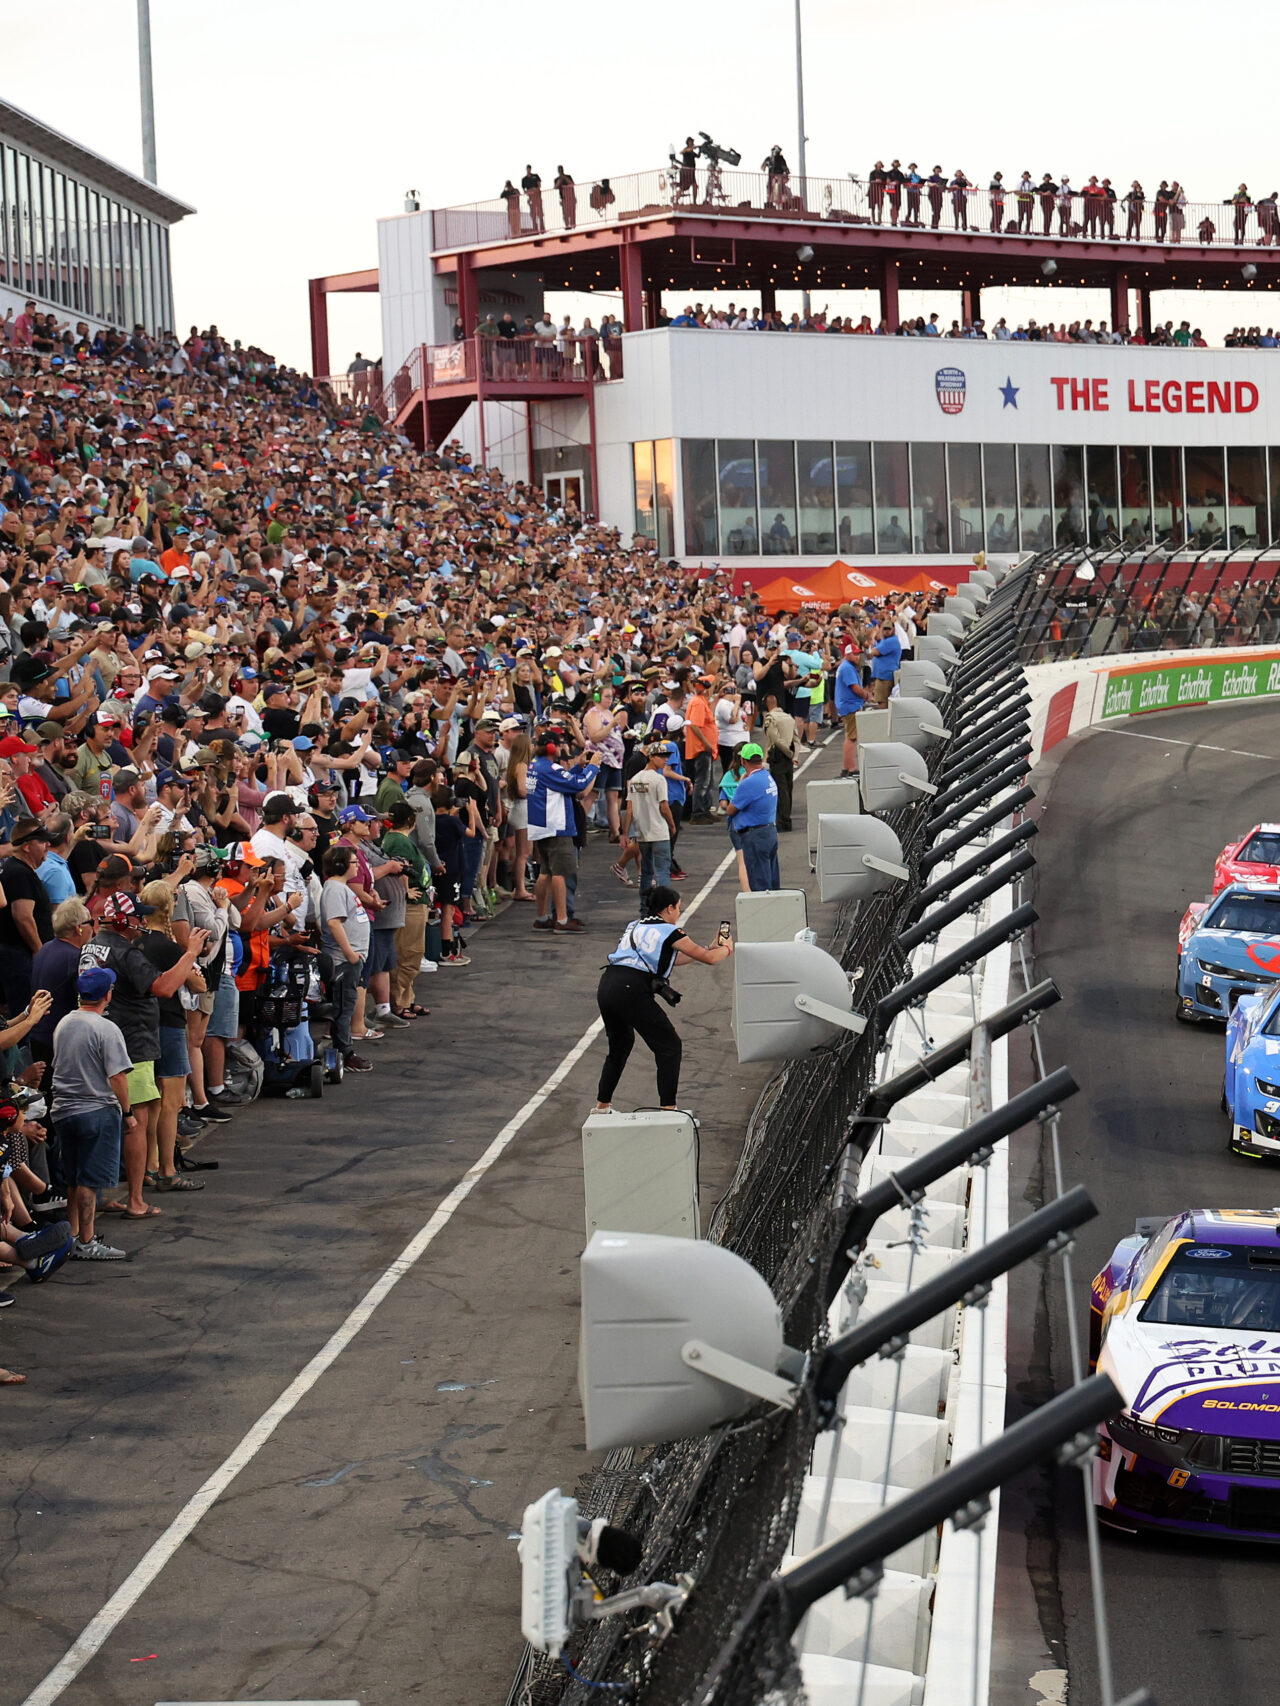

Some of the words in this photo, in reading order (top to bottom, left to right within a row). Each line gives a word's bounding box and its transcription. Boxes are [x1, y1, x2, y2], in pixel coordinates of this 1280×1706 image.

[1050, 377, 1109, 411] THE
[1128, 379, 1259, 413] LEGEND
[1177, 668, 1213, 701] EchoPark
[1221, 665, 1258, 696] EchoPark
[1202, 976, 1212, 988] 8
[1263, 1101, 1280, 1113] 9
[1168, 1468, 1190, 1489] 6
